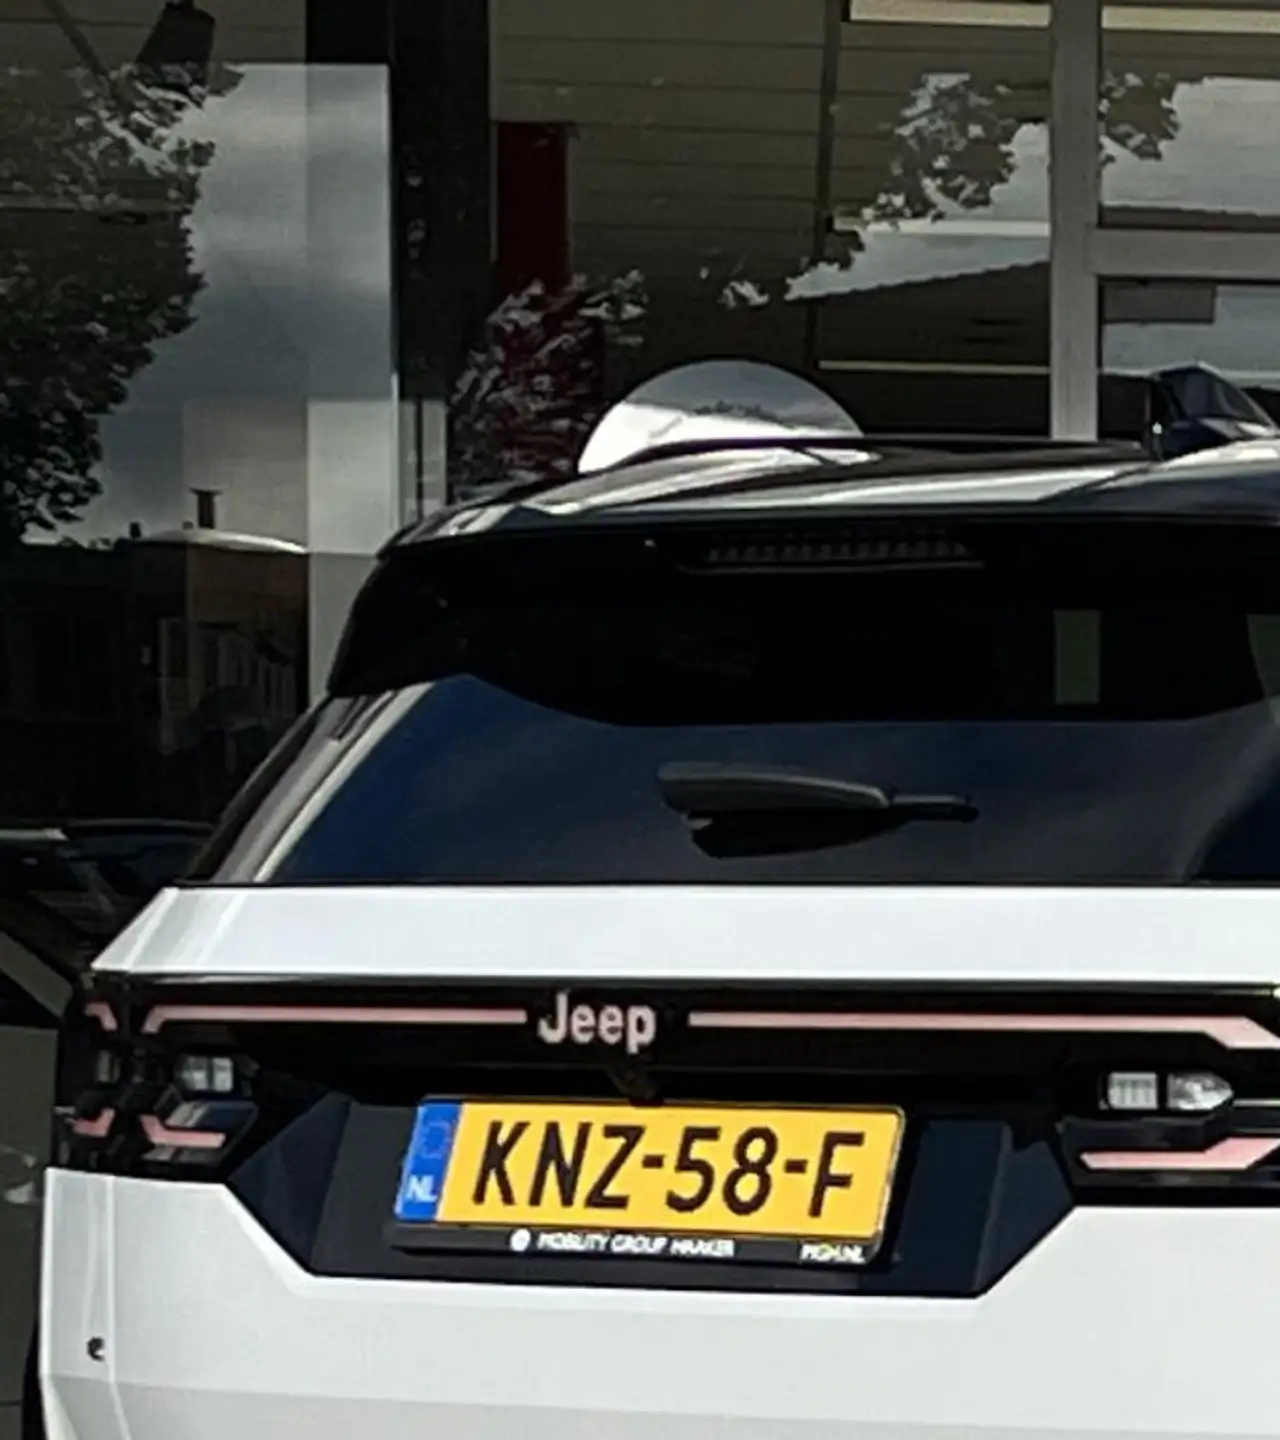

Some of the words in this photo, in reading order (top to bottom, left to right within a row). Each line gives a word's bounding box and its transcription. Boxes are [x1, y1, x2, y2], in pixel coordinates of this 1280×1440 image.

[537, 990, 657, 1055] Jeep
[405, 1174, 438, 1200] NL
[471, 1119, 867, 1219] KNZ-58-F
